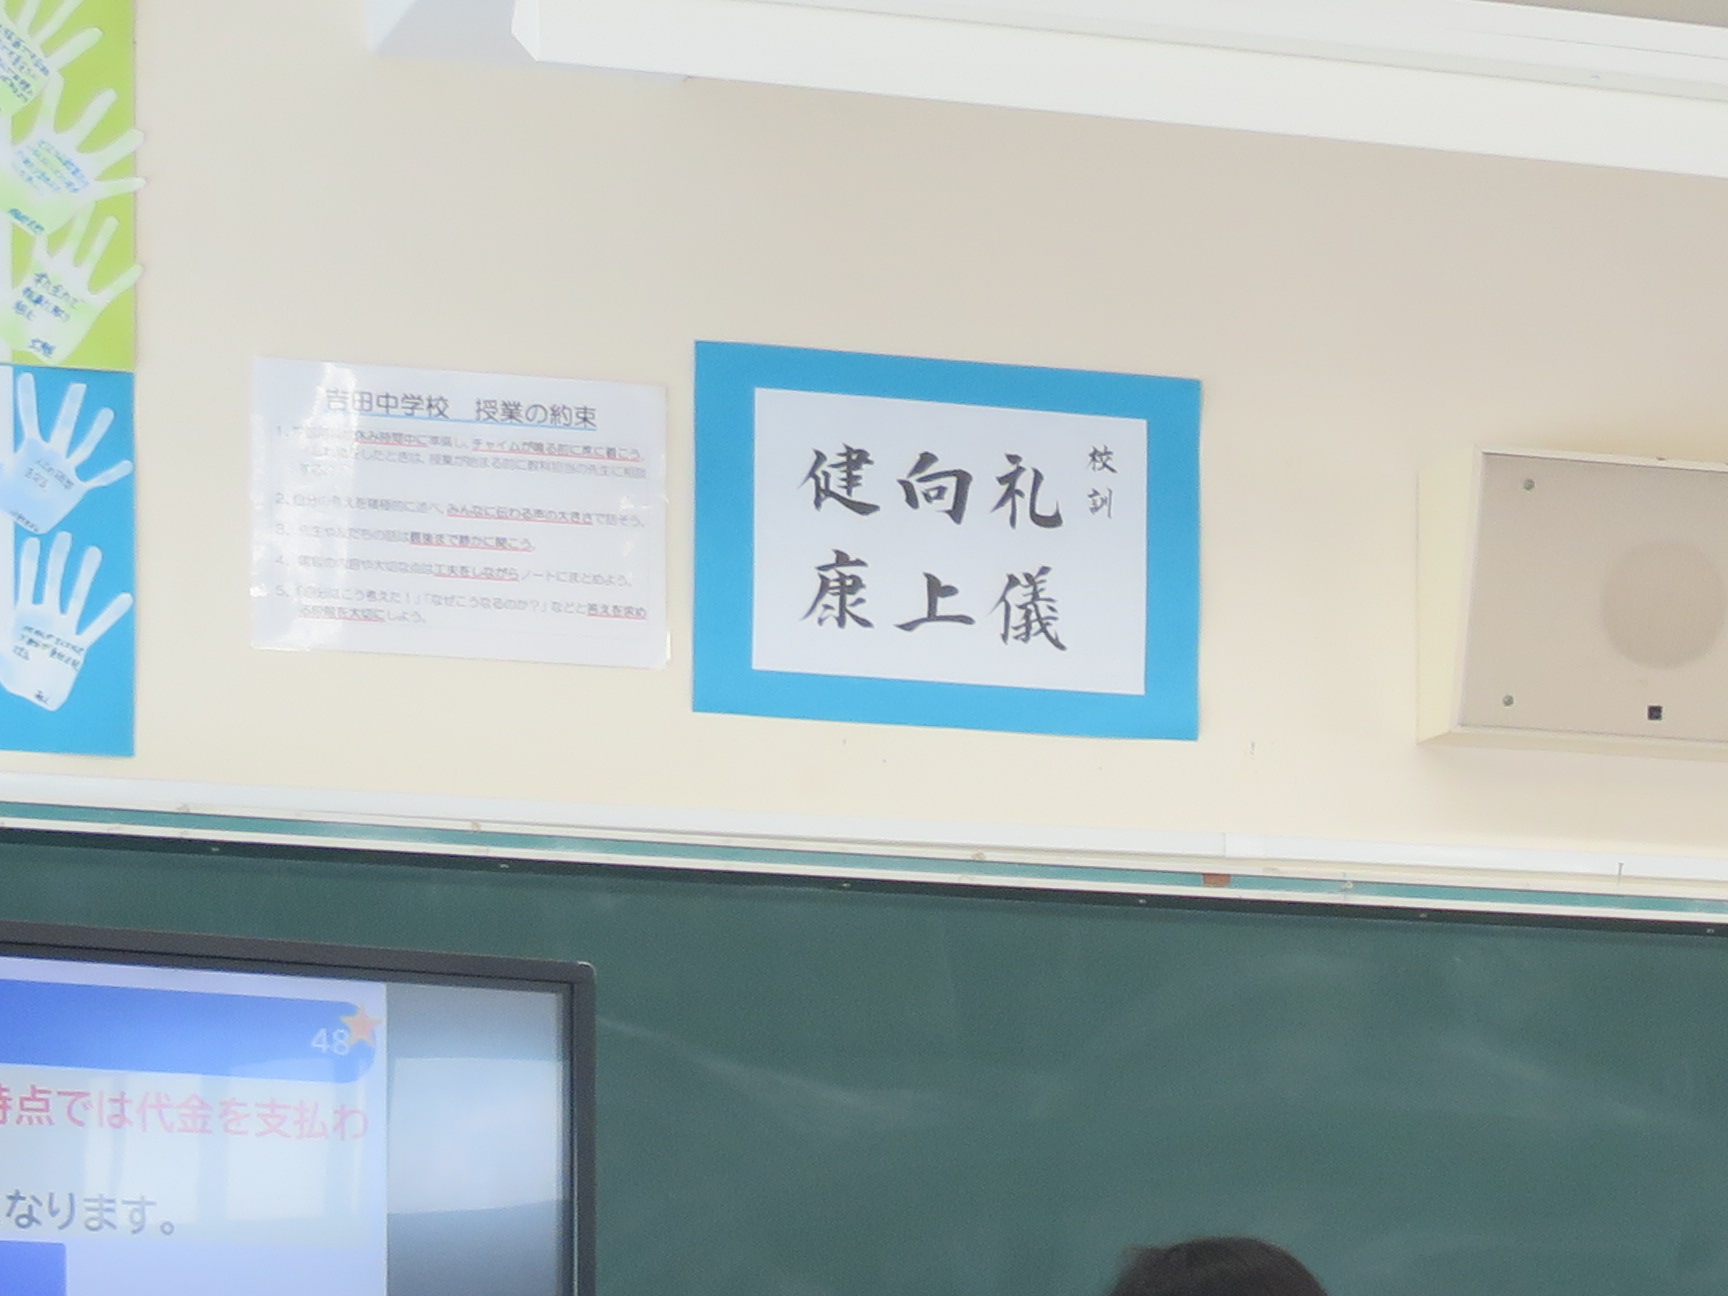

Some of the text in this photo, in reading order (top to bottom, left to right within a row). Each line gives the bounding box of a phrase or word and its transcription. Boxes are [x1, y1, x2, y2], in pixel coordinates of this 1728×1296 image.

[326, 389, 598, 428] 吉田中学校 授業の約束
[1086, 445, 1118, 519] 校訓
[798, 443, 881, 631] 健康
[895, 451, 977, 632] 向上
[985, 454, 1068, 652] 礼儀
[310, 1027, 350, 1057] 48
[6, 1189, 175, 1236] なります。
